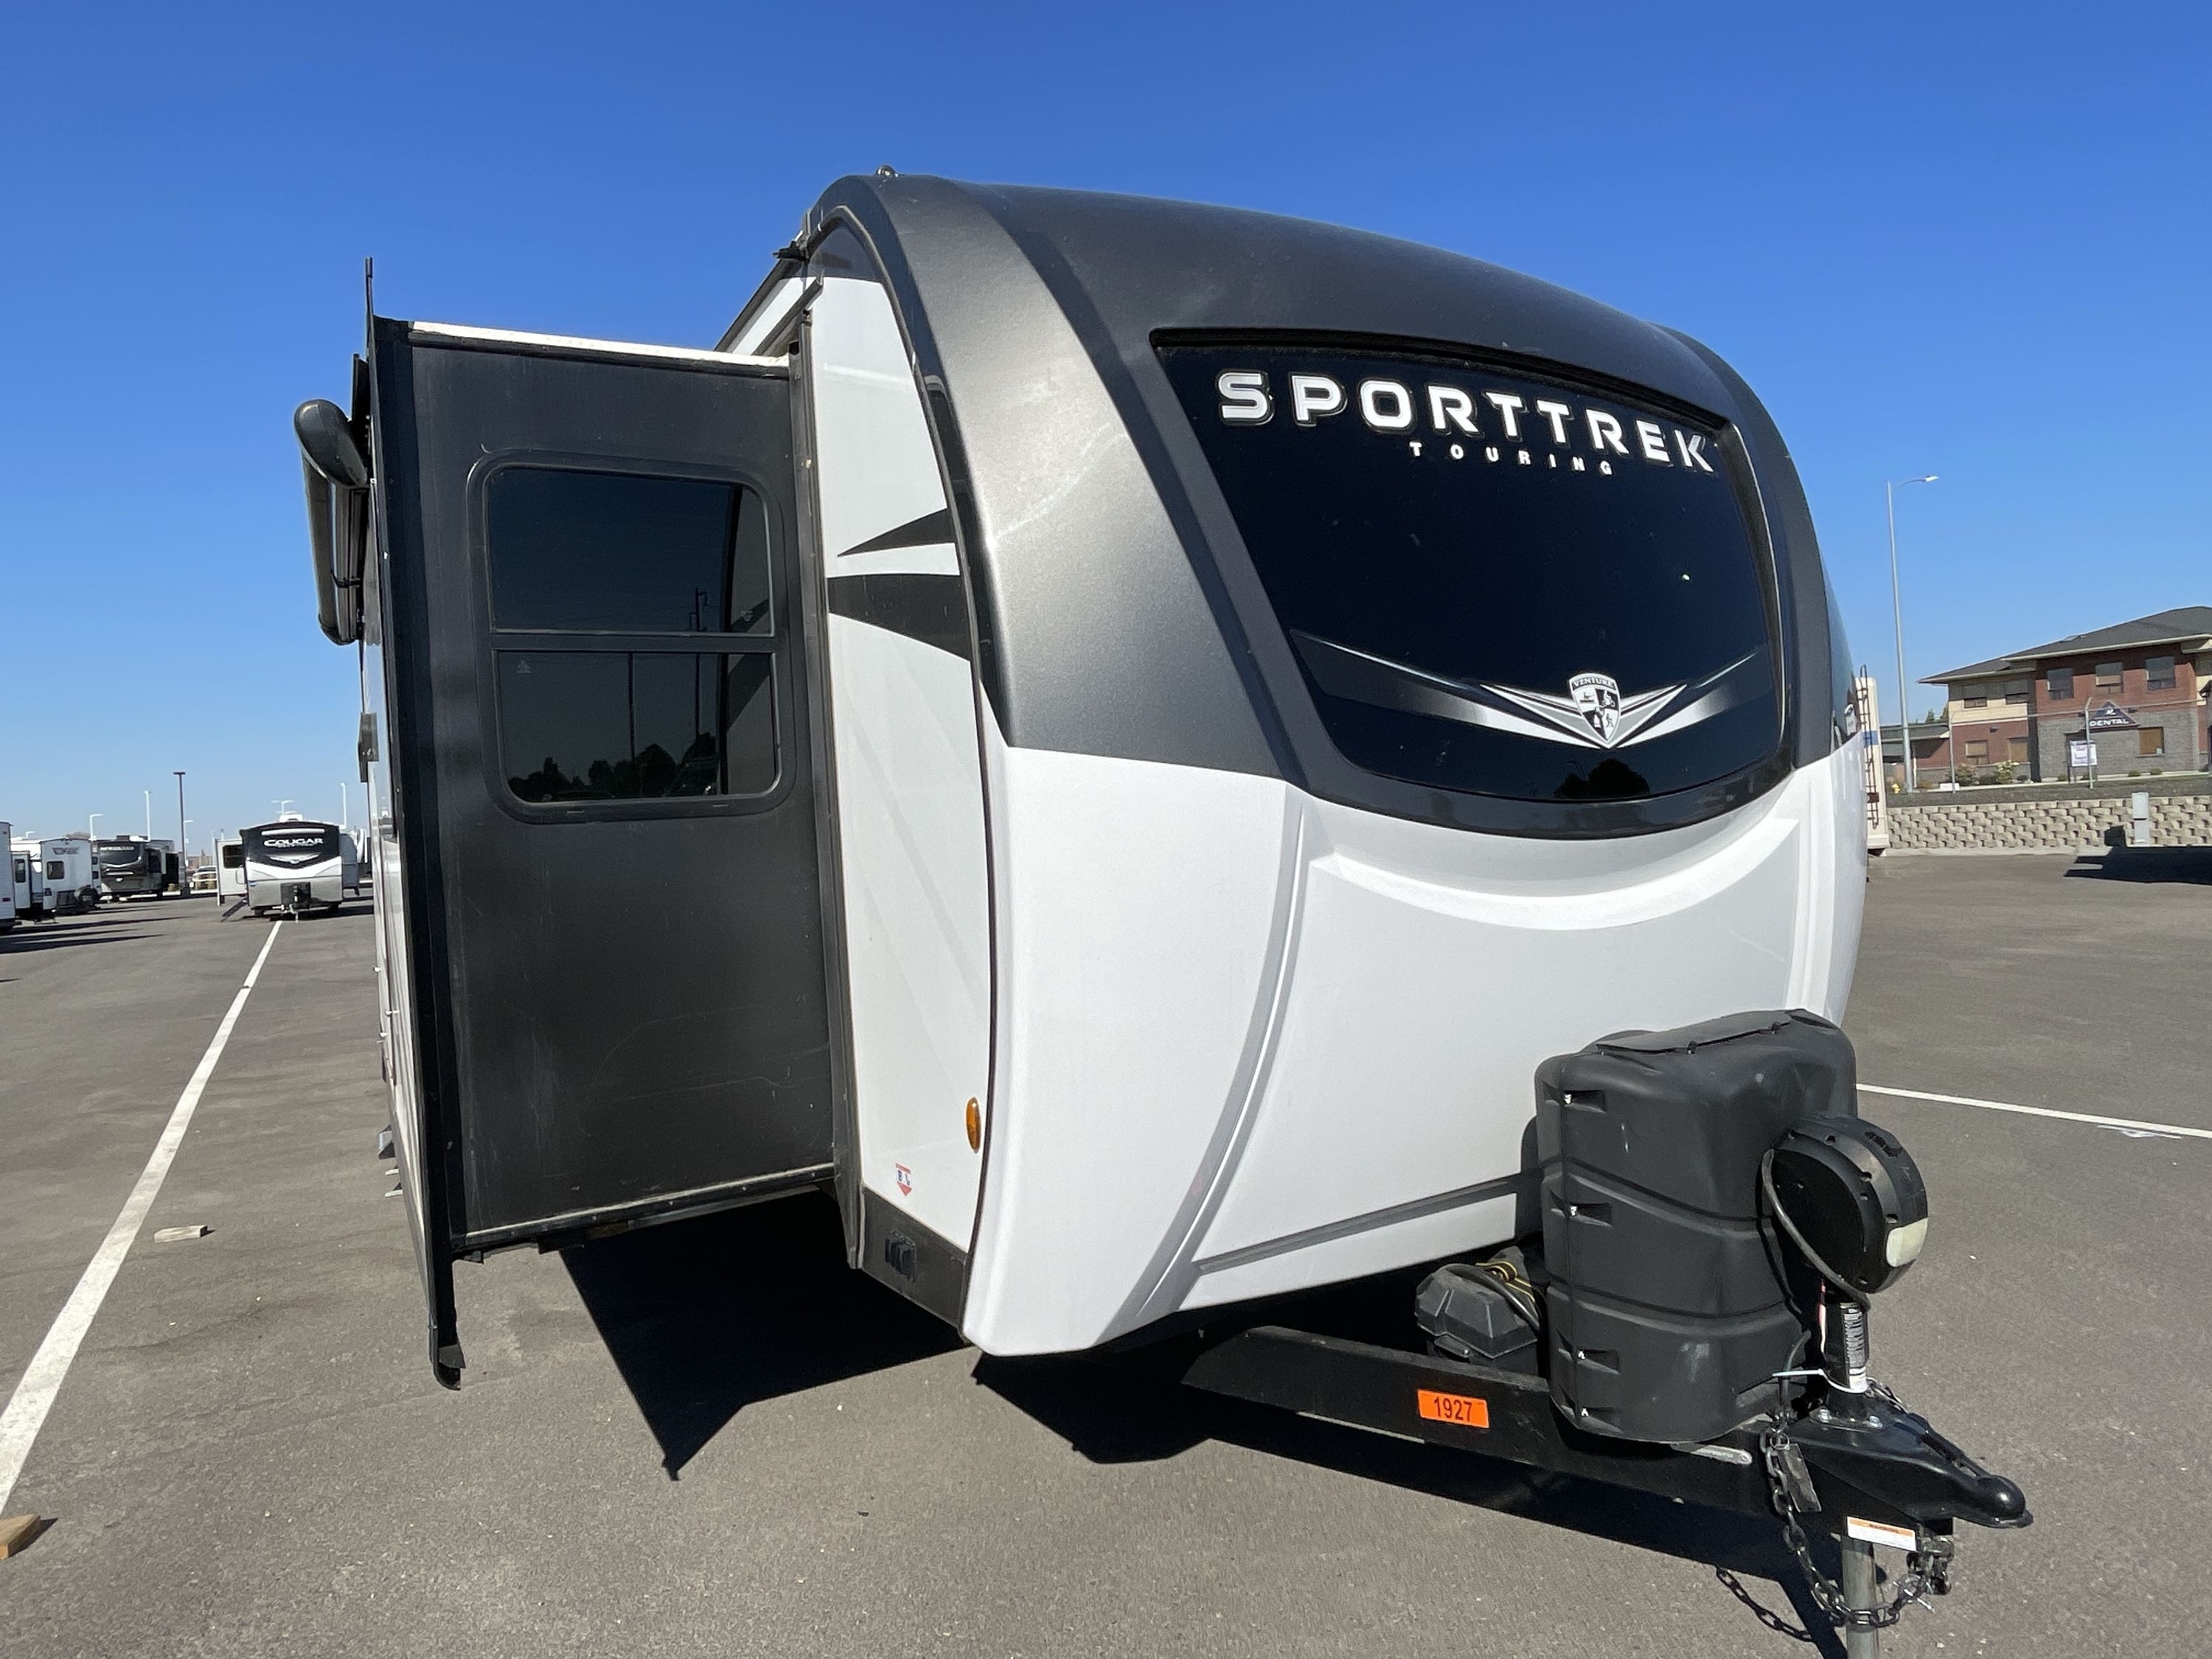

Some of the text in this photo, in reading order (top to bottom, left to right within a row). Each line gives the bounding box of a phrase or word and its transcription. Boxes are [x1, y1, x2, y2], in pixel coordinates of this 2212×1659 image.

[1217, 370, 1714, 473] SPORTTREK
[1408, 442, 1613, 476] TOURING
[1573, 677, 1615, 688] VENTURE
[2089, 718, 2129, 727] DENTAL
[263, 838, 324, 847] COUGAR
[1433, 1397, 1472, 1422] 1927
